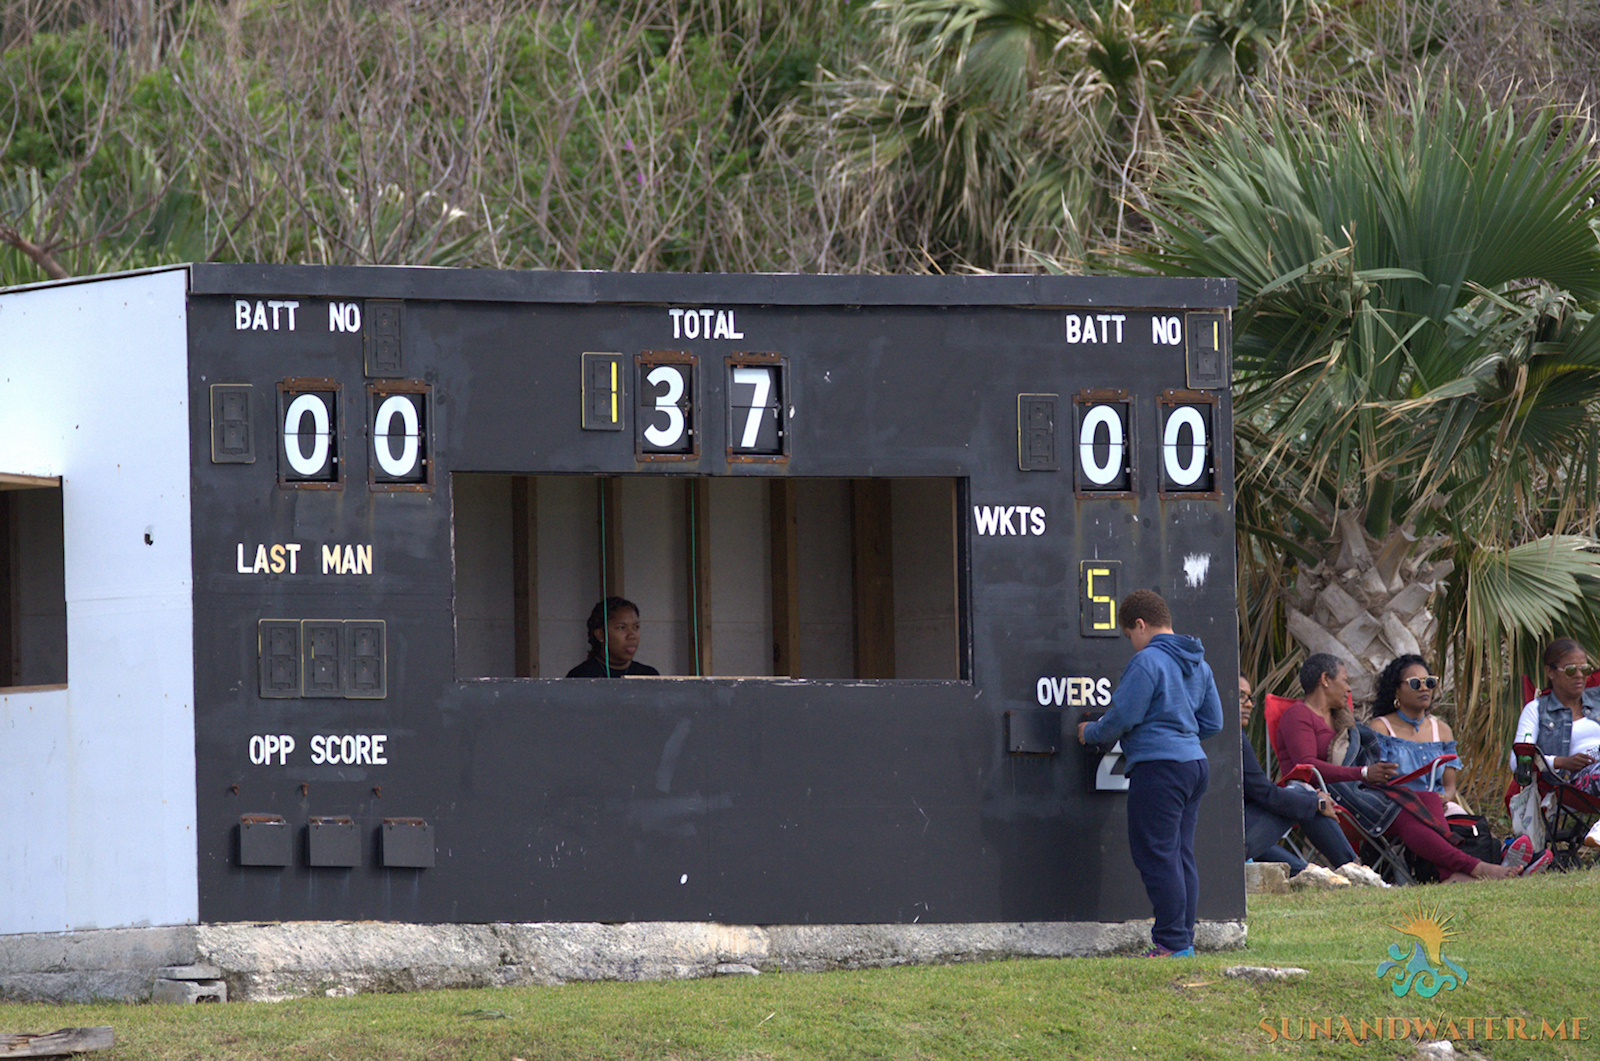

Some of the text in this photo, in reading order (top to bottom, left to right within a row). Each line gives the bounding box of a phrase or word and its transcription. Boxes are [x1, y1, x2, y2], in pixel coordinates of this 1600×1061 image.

[235, 300, 361, 332] BATT NO
[668, 308, 744, 339] TOTAL
[1065, 314, 1181, 345] BATT NO
[973, 505, 1046, 536] WKTS
[237, 543, 373, 575] LAST MAN
[1087, 568, 1116, 630] 5
[1037, 676, 1112, 706] OVERS
[249, 734, 387, 765] OPP SCORE
